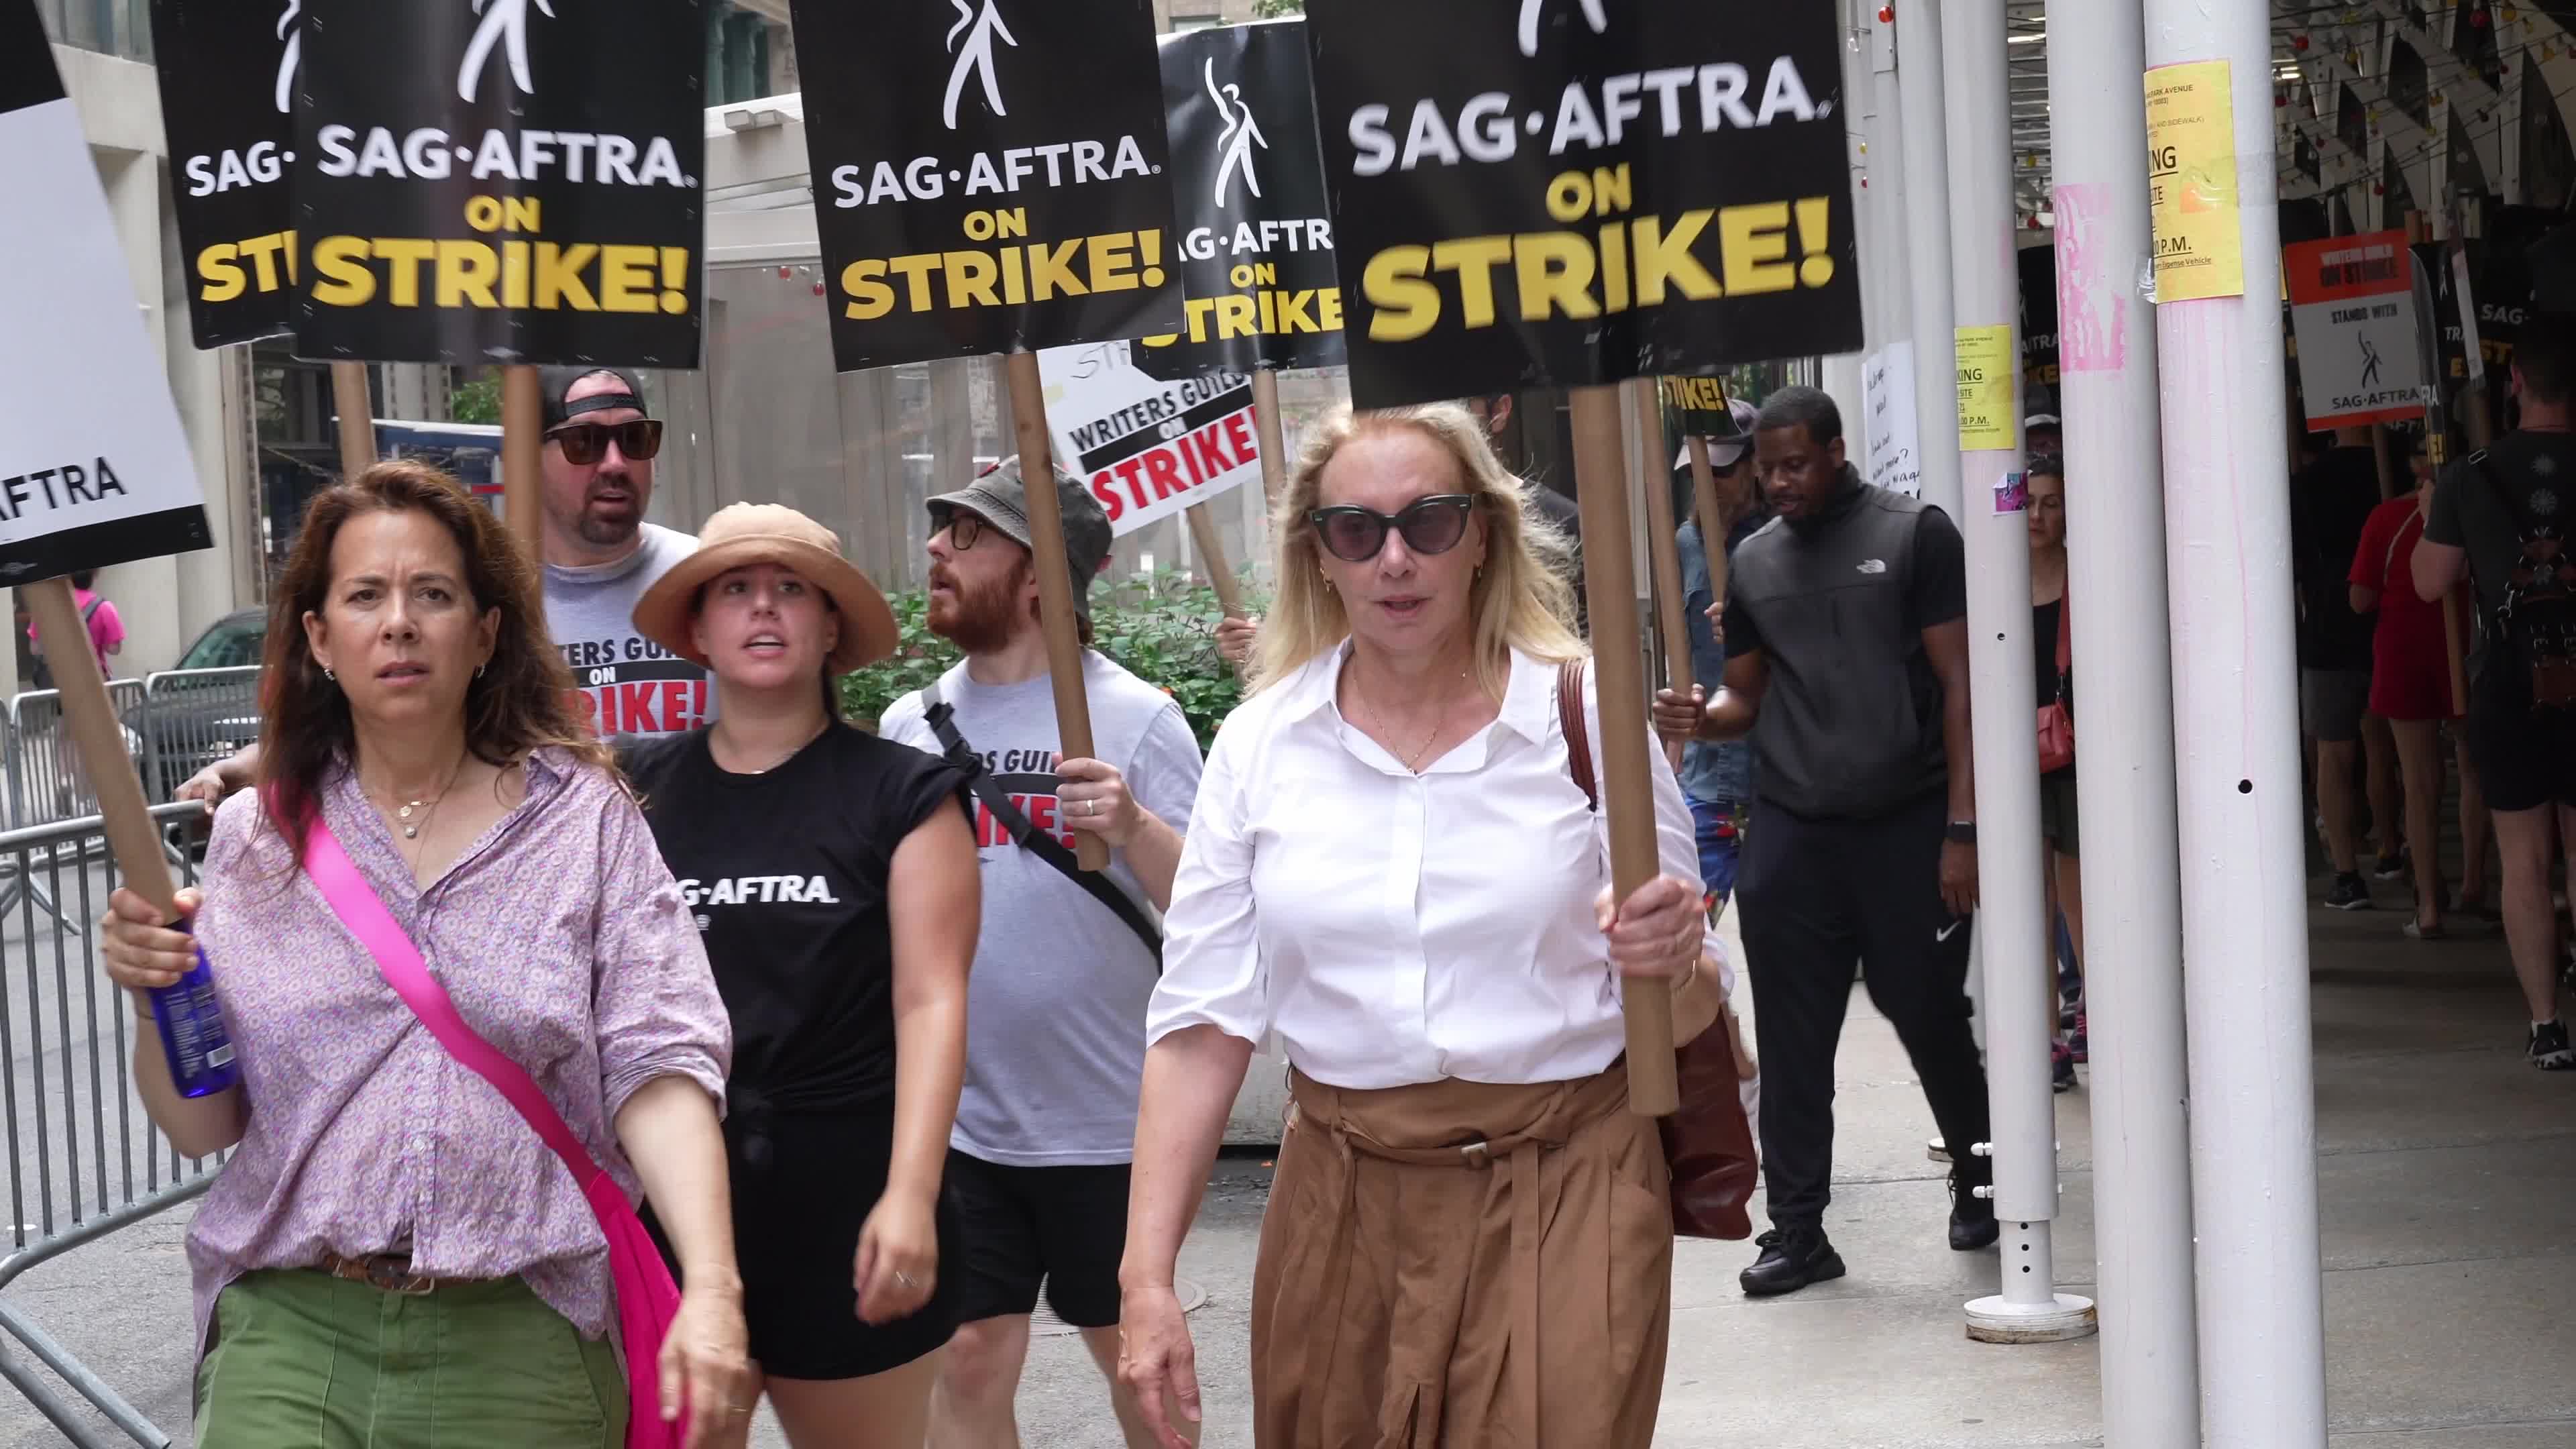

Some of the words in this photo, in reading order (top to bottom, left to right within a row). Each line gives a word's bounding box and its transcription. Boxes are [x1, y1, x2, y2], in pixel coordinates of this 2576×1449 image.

[2165, 85, 2194, 93] AVENUE
[1546, 162, 1631, 223] ON
[464, 195, 541, 233] ON
[963, 207, 1027, 241] ON
[2161, 236, 2192, 253] P.M.
[311, 236, 689, 315] STRIKE!
[841, 229, 1165, 320] STRIKE!
[1230, 263, 1276, 287] ON
[1362, 196, 1834, 342] STRIKE!
[1141, 287, 1344, 347] TRIKE
[2331, 308, 2367, 324] STANDS
[2372, 303, 2398, 318] WITH
[1069, 391, 1176, 451] WRITERS
[1158, 417, 1188, 440] ON
[1970, 416, 1990, 425] P.M.
[0, 457, 128, 521] FTRA
[589, 667, 616, 685] ON
[1005, 749, 1056, 772] GUI
